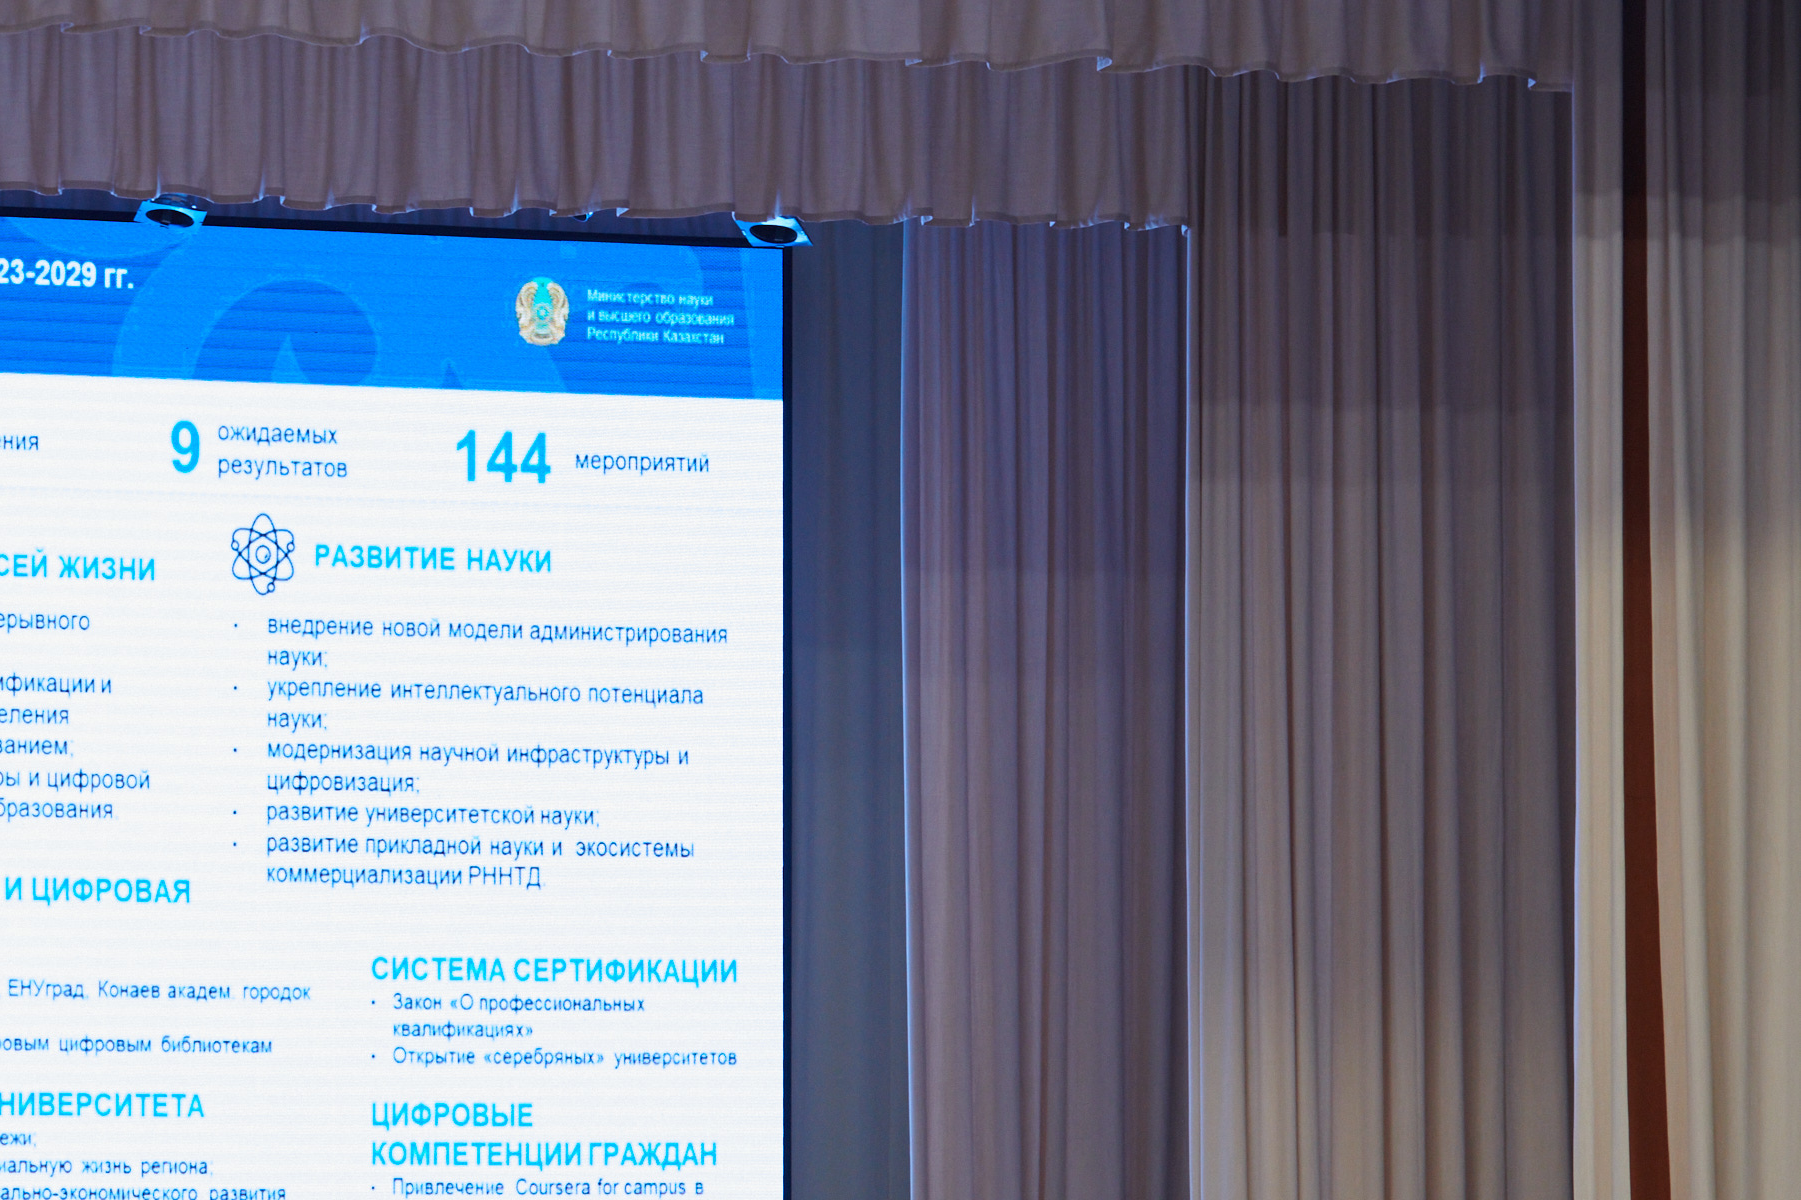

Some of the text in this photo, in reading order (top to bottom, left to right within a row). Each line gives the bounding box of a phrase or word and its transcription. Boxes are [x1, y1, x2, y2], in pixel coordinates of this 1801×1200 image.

[105, 267, 133, 289] гг.
[587, 289, 714, 309] Министерство науки
[587, 310, 735, 326] и высшего образования
[587, 327, 725, 344] Республики Казахстан
[171, 420, 200, 474] 9
[218, 425, 337, 446] ожидаемых
[218, 458, 347, 480] результатов
[456, 429, 551, 484] 144
[575, 454, 709, 476] мероприятий
[59, 555, 155, 582] ЖИЗНИ
[315, 544, 551, 573] РАЗВИТИЕ НАУКИ
[268, 617, 727, 647] внедрение новой модели администрирования
[268, 680, 703, 708] укрепление интеллектуального потенциала
[268, 742, 688, 771] модернизация научной инфраструктуры и
[5, 876, 22, 901] И
[32, 876, 190, 906] ЦИФРОВАЯ
[371, 956, 737, 988] СИСТЕМА СЕРТИФИКАЦИИ
[59, 1036, 151, 1056] цифровым
[161, 1034, 272, 1054] библиотекам
[393, 1046, 737, 1070] Открытие «серебряных» университетов
[372, 1102, 533, 1132] ЦИФРОВЫЕ
[372, 1141, 717, 1171] КОМПЕТЕНЦИИ ГРАЖДАН
[393, 1176, 704, 1198] Привлечение Coursera for campus в
